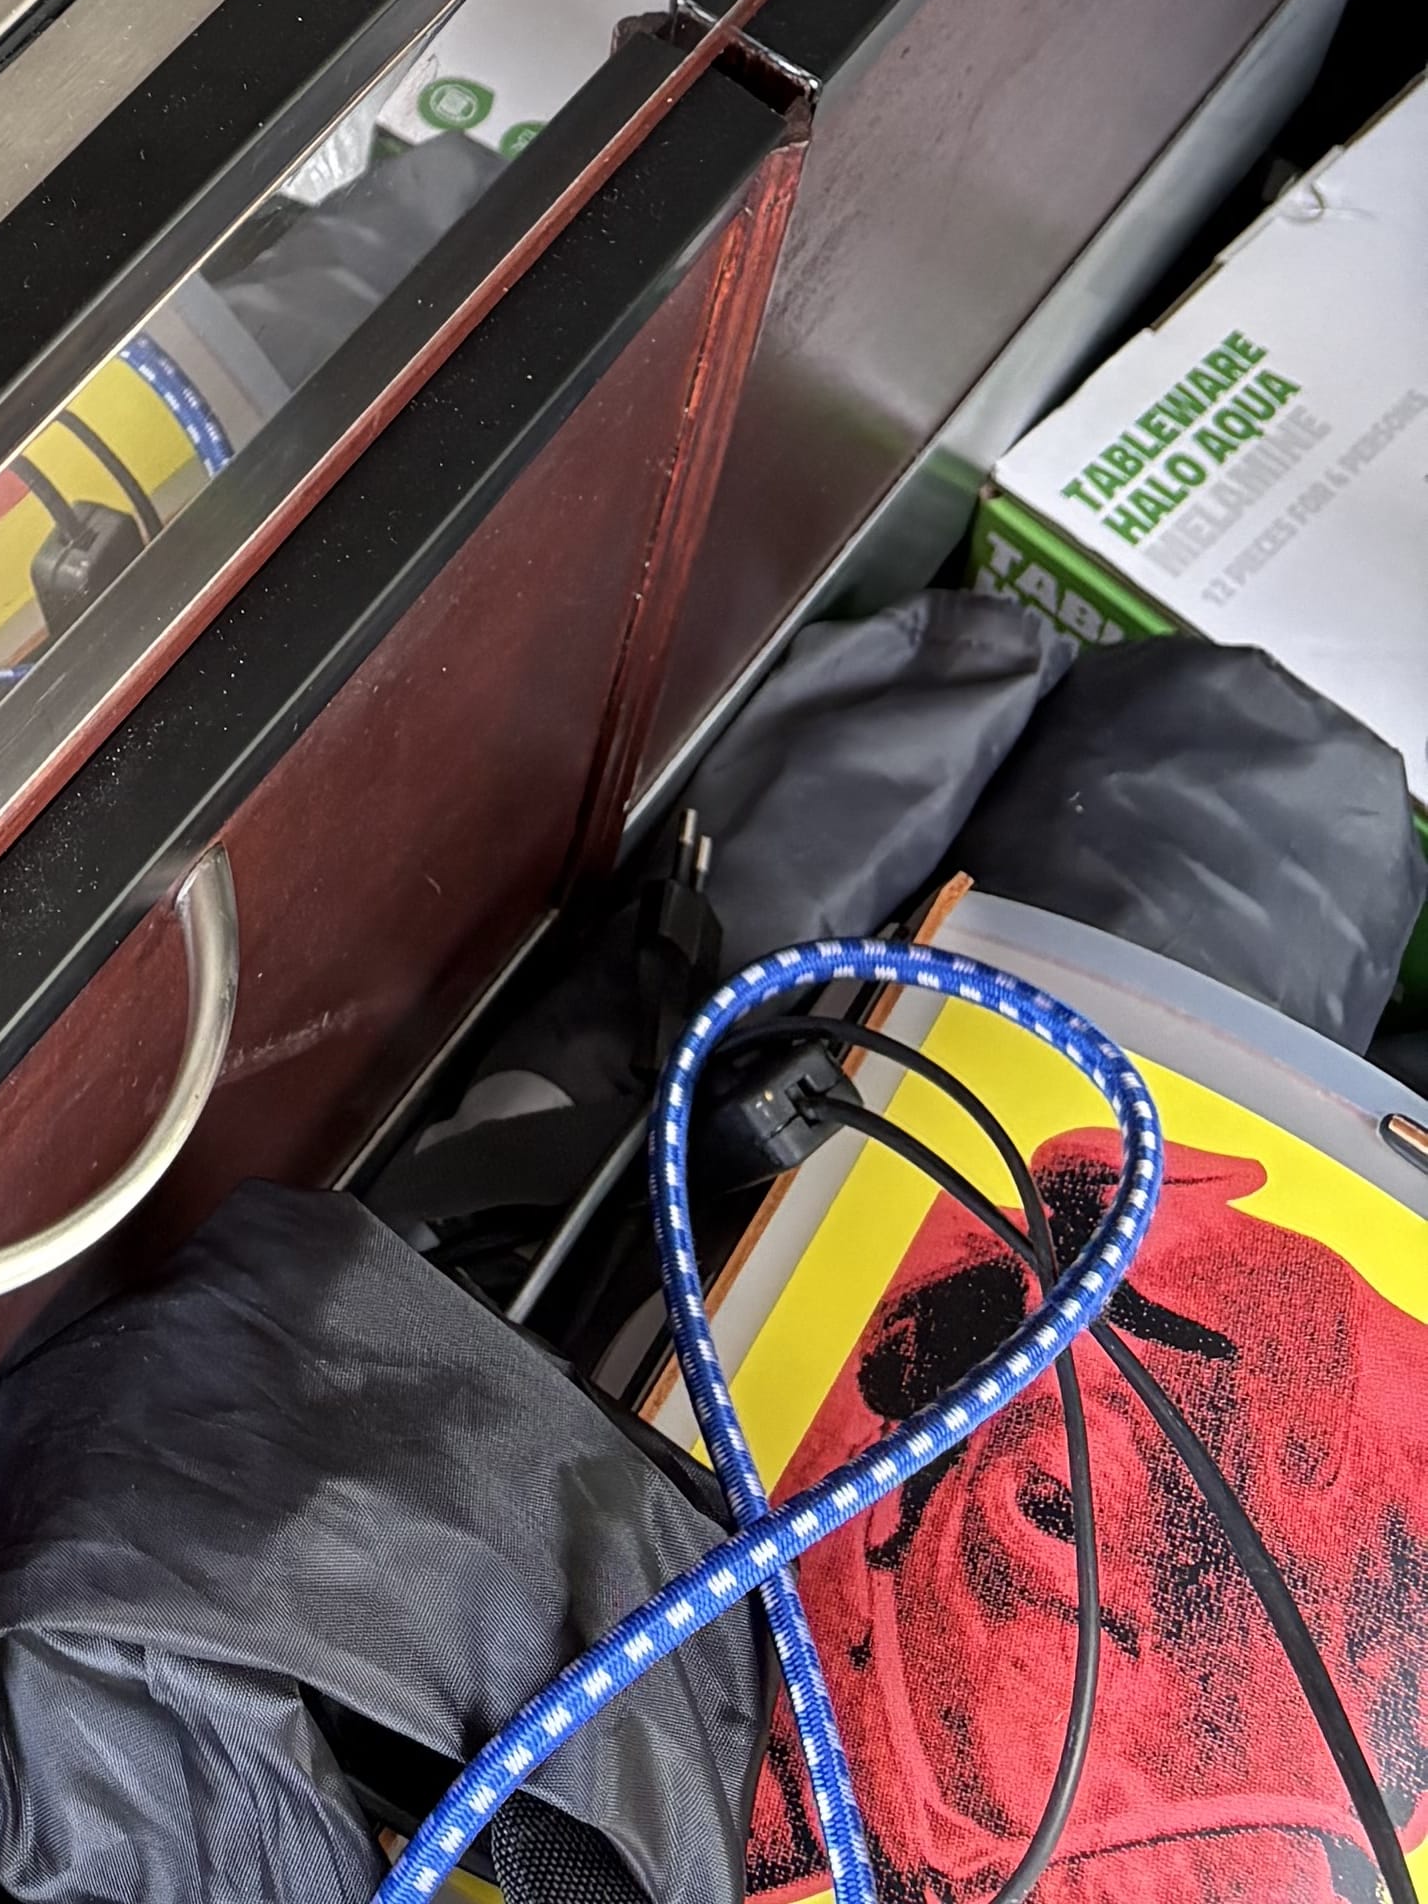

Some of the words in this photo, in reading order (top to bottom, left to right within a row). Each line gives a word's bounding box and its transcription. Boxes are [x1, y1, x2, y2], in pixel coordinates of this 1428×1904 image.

[1060, 329, 1269, 512] TABLEWARE
[1101, 452, 1208, 546] HALO
[1192, 369, 1302, 466] AQUA
[1143, 405, 1333, 579] MELAMINE
[1201, 577, 1236, 607] 12
[1223, 517, 1298, 586] PIECES
[1287, 480, 1337, 526] FOR
[1337, 389, 1428, 475] PERSONS
